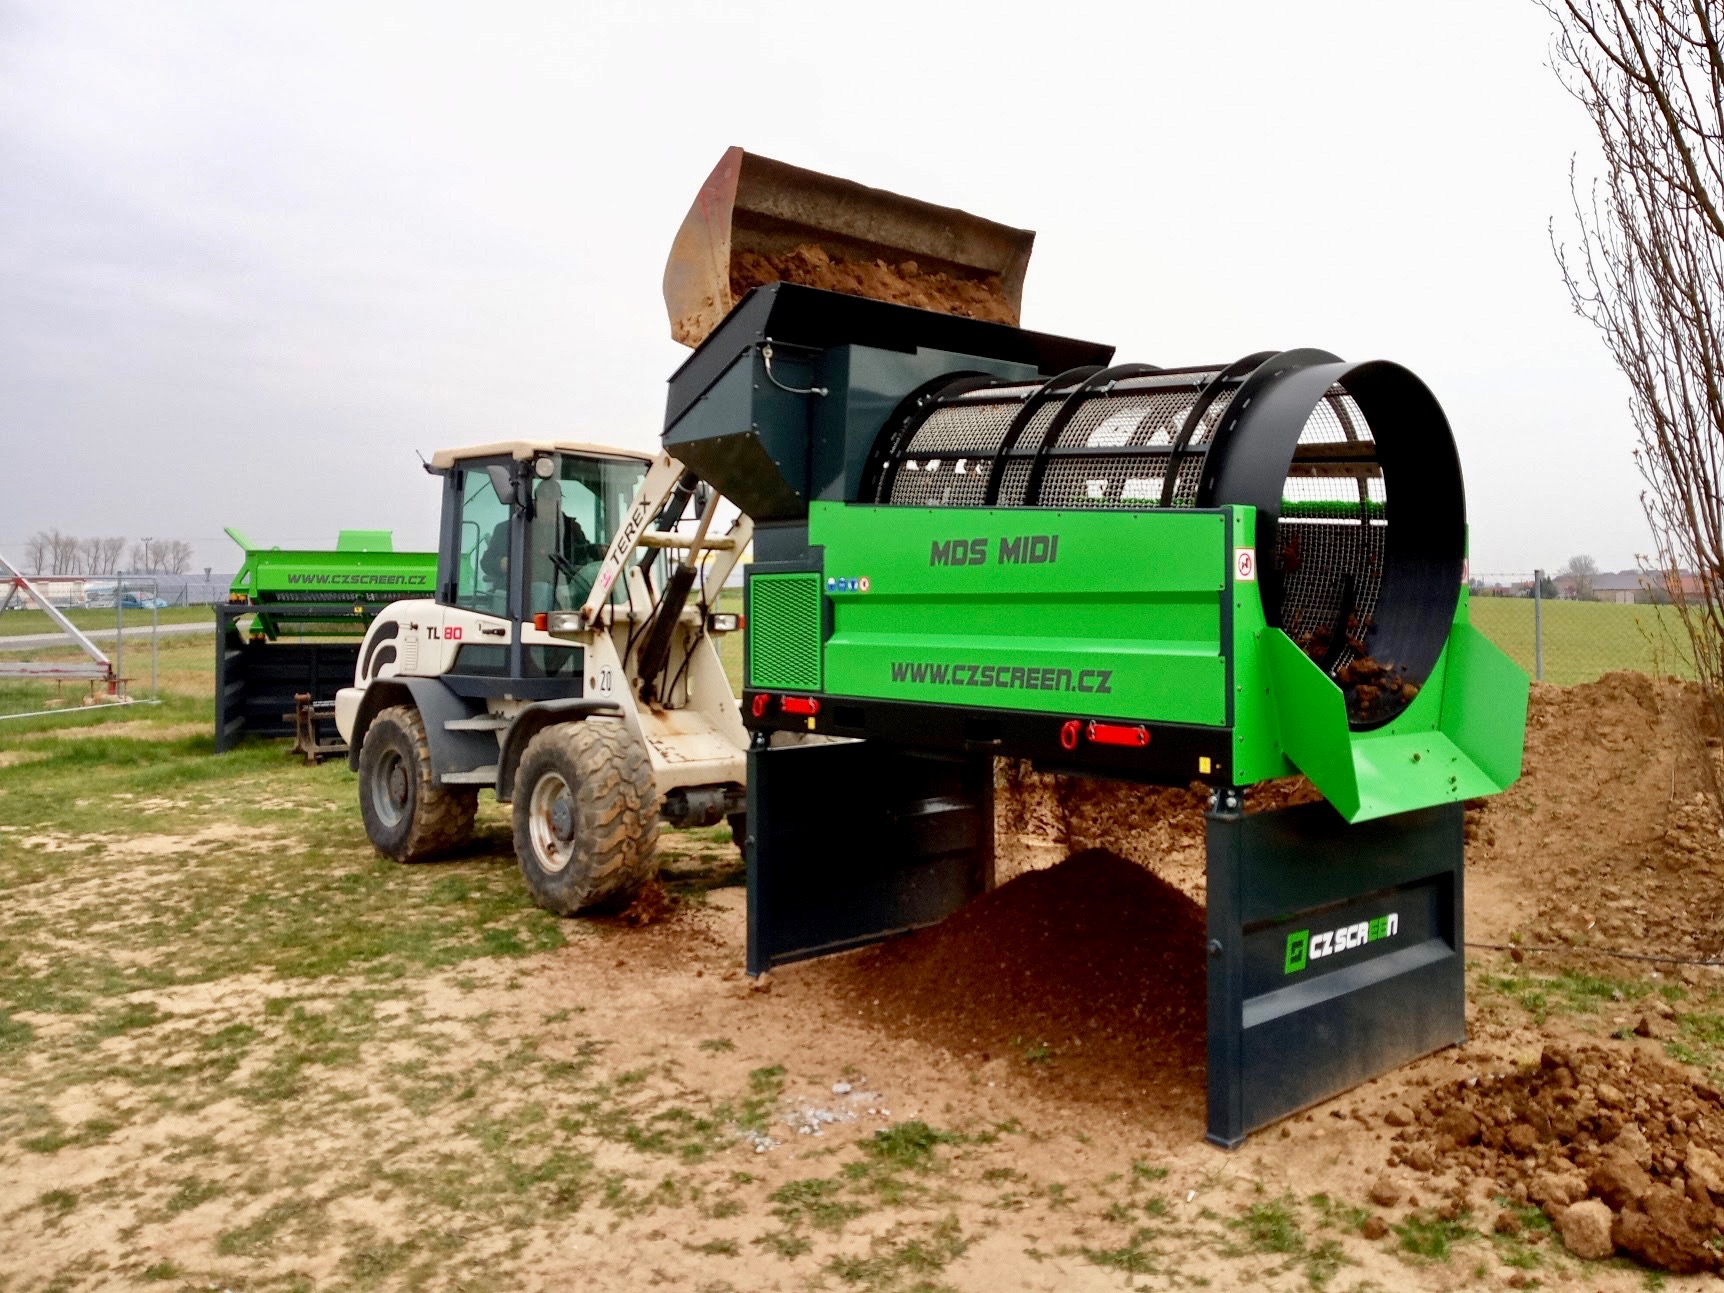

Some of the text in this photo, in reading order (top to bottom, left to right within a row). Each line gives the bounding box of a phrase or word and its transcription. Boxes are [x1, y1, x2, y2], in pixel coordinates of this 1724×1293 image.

[610, 493, 652, 565] TEREX
[929, 535, 1059, 567] MDS MIDI
[287, 573, 427, 585] WWW.CZSCREEN.CZ
[426, 627, 463, 640] TL 80
[600, 670, 612, 691] 20
[891, 661, 1113, 694] WWW.CZSCREEN.CZ
[1310, 913, 1399, 960] CZSCREEN
